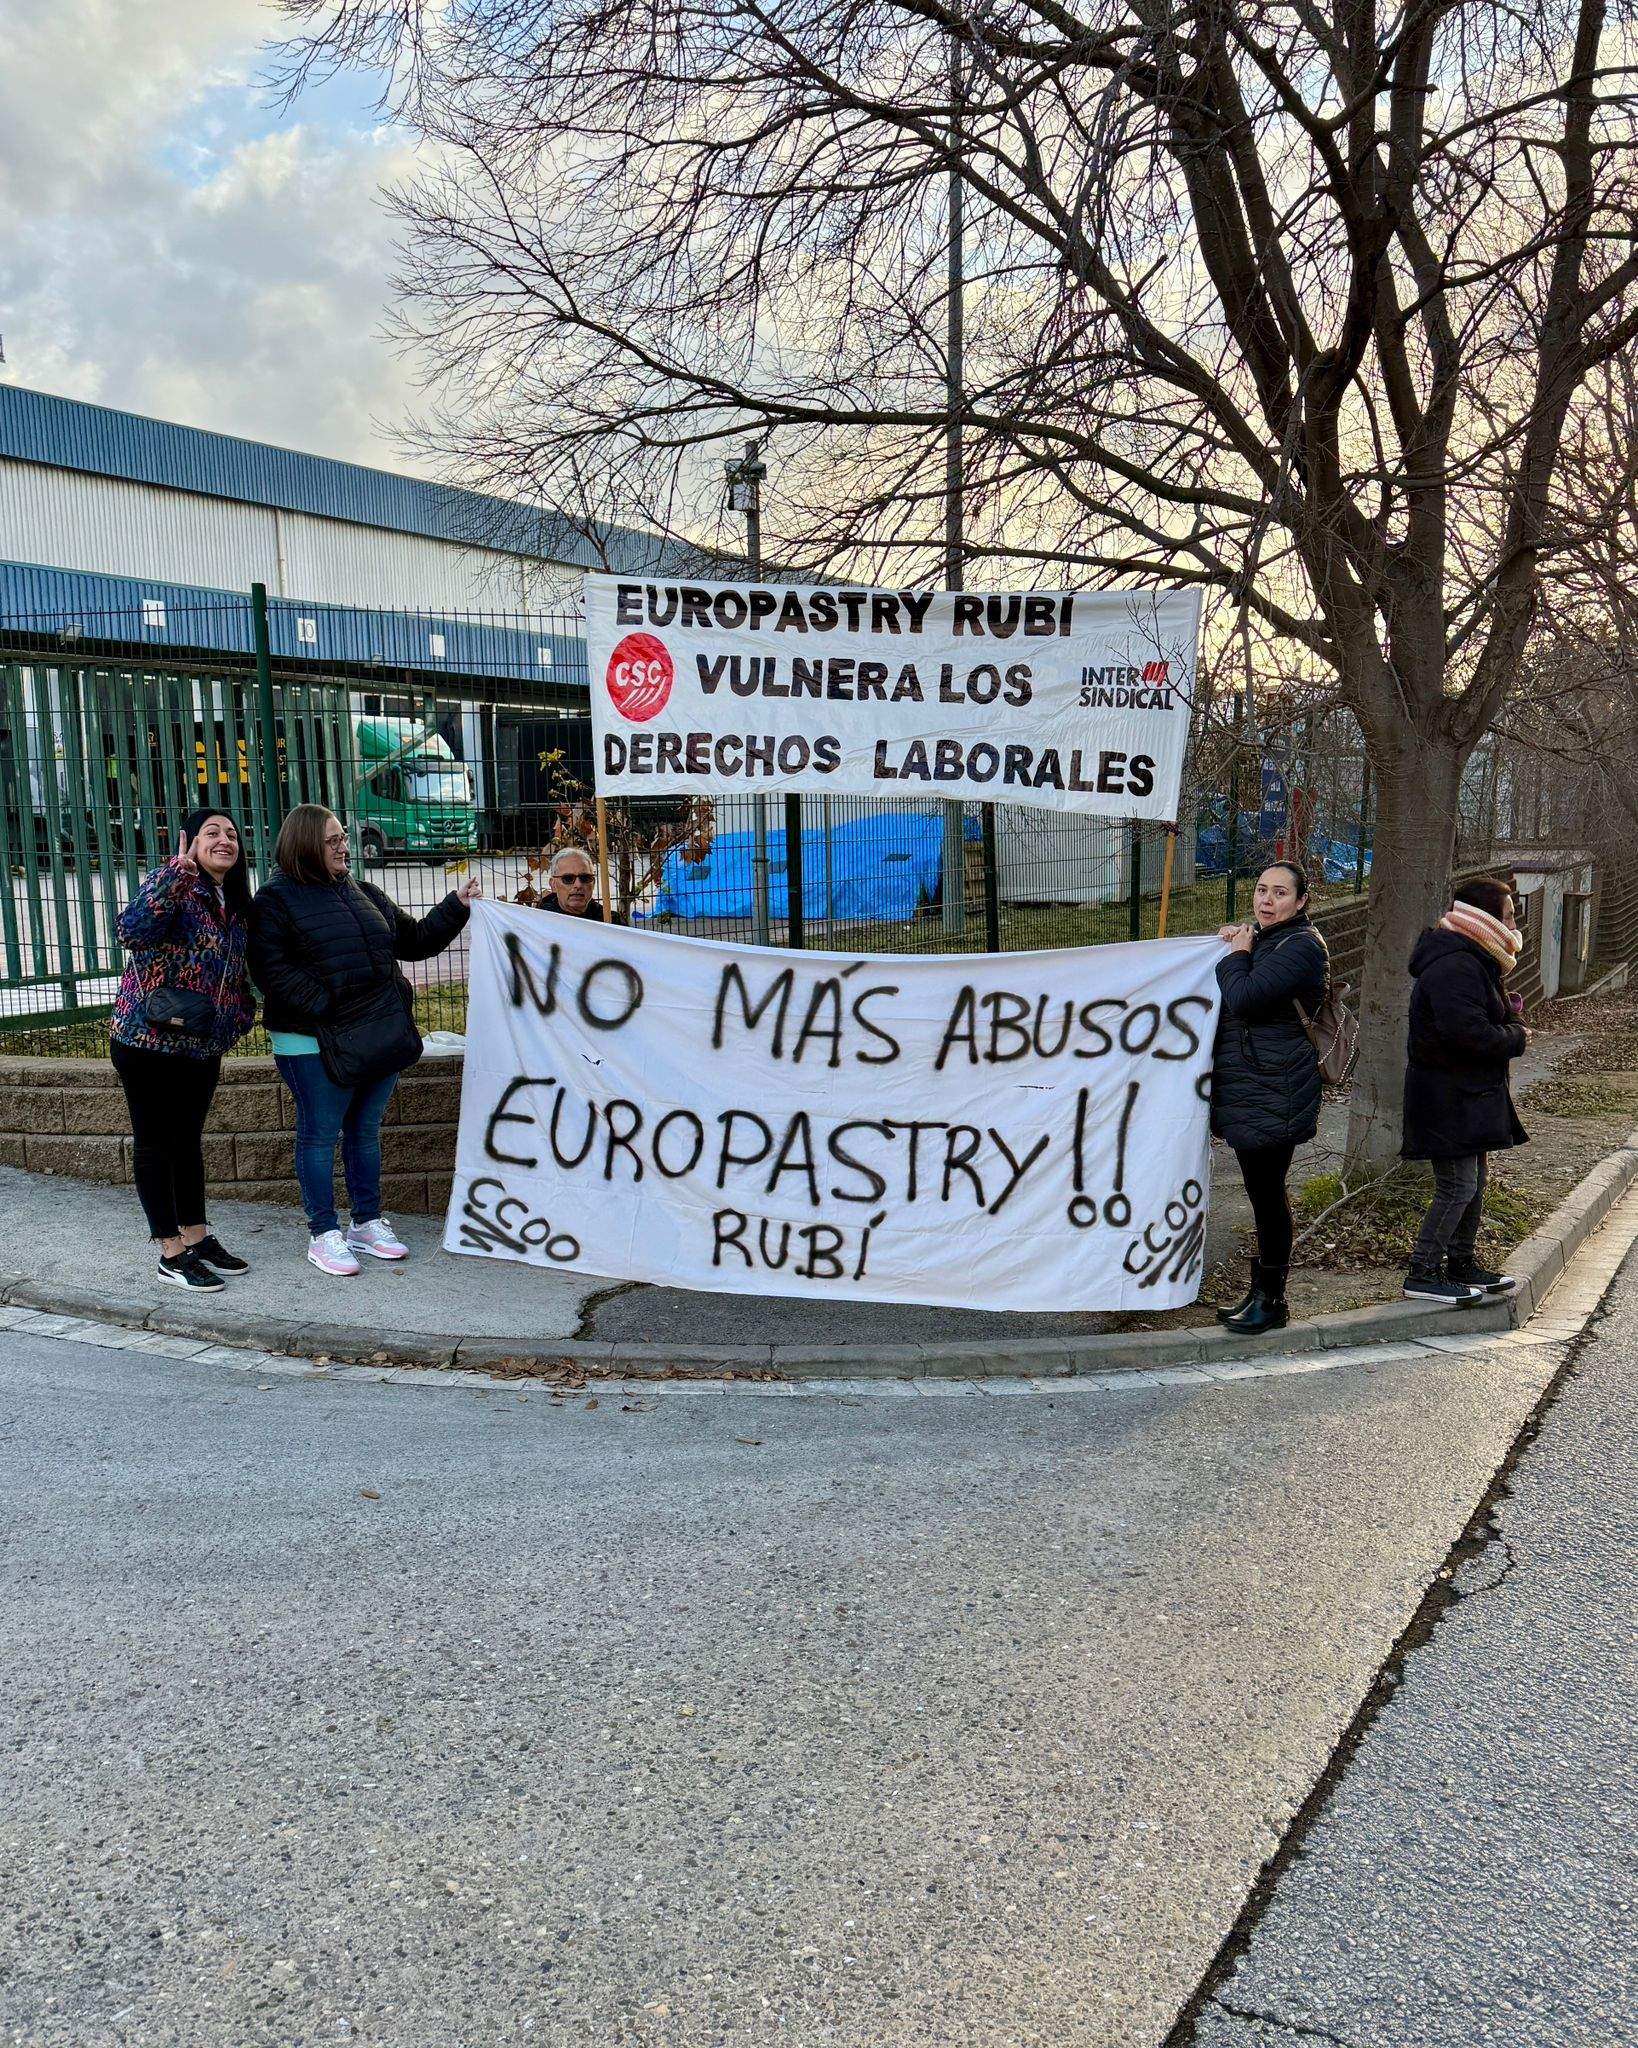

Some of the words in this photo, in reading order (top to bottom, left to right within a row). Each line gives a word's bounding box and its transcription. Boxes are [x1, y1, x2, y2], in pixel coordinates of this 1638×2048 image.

[616, 584, 935, 635] EUROPASTRY
[615, 660, 662, 687] CSC
[695, 654, 926, 703] VULNERA
[938, 663, 1034, 708] LOS
[1078, 686, 1174, 710] SINDICAL
[1081, 666, 1139, 687] INTER
[603, 732, 842, 777] DERECHOS
[873, 739, 1157, 798] LABORALES
[504, 931, 644, 1031] NO
[711, 960, 901, 1068] MÁS
[934, 984, 1213, 1070] ABUSOS
[482, 1075, 1050, 1215] EUROPASTRY
[468, 1177, 580, 1262] CCOO
[712, 1207, 888, 1281] RUBÍ
[1122, 1178, 1203, 1275] CCOO
